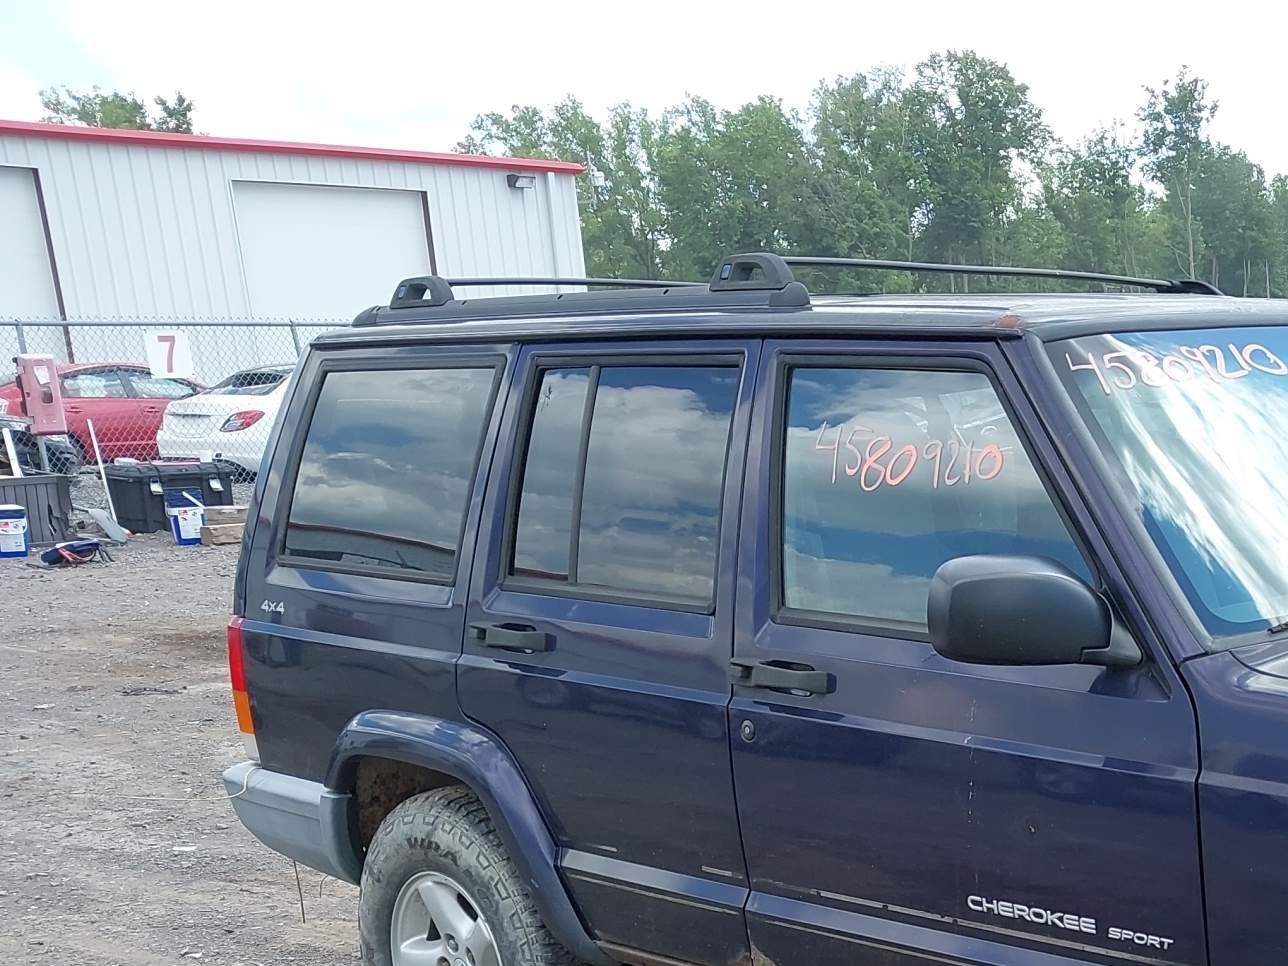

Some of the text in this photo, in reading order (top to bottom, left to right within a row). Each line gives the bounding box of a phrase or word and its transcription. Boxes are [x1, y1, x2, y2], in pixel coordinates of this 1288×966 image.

[157, 335, 176, 373] 7
[1064, 342, 1288, 396] 45809210
[815, 421, 1005, 491] 45809210
[967, 895, 1174, 950] CHEROKEE SPORT
